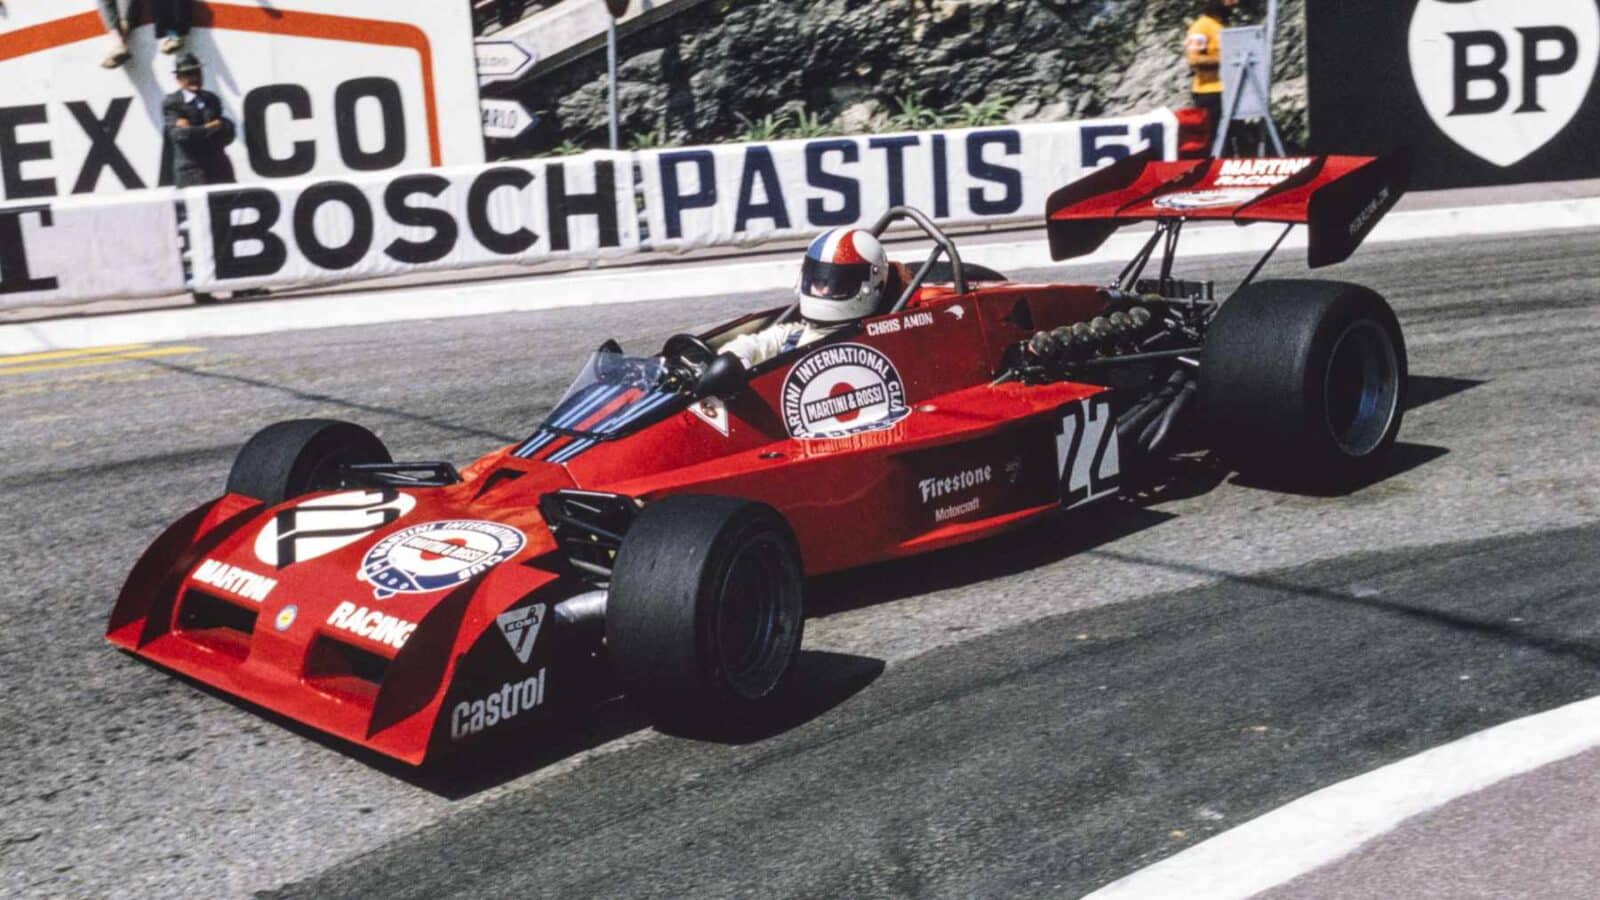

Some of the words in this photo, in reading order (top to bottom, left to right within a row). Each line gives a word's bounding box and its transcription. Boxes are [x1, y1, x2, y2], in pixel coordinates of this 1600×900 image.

[1443, 25, 1579, 117] BP
[658, 129, 1022, 239] PASTIS
[1080, 122, 1164, 168] 51
[207, 160, 620, 280] BOSCH
[866, 318, 901, 336] CHRIS
[903, 312, 934, 329] AMON
[795, 347, 889, 384] INTERNATIONAL
[806, 395, 847, 421] MARTINI
[857, 386, 883, 406] ROSSI
[1056, 393, 1120, 507] 22
[918, 464, 992, 503] Firestone
[935, 496, 980, 522] Motorcraft
[192, 558, 278, 602] MARTINI
[326, 600, 418, 649] RACING
[450, 667, 546, 739] Castrol
